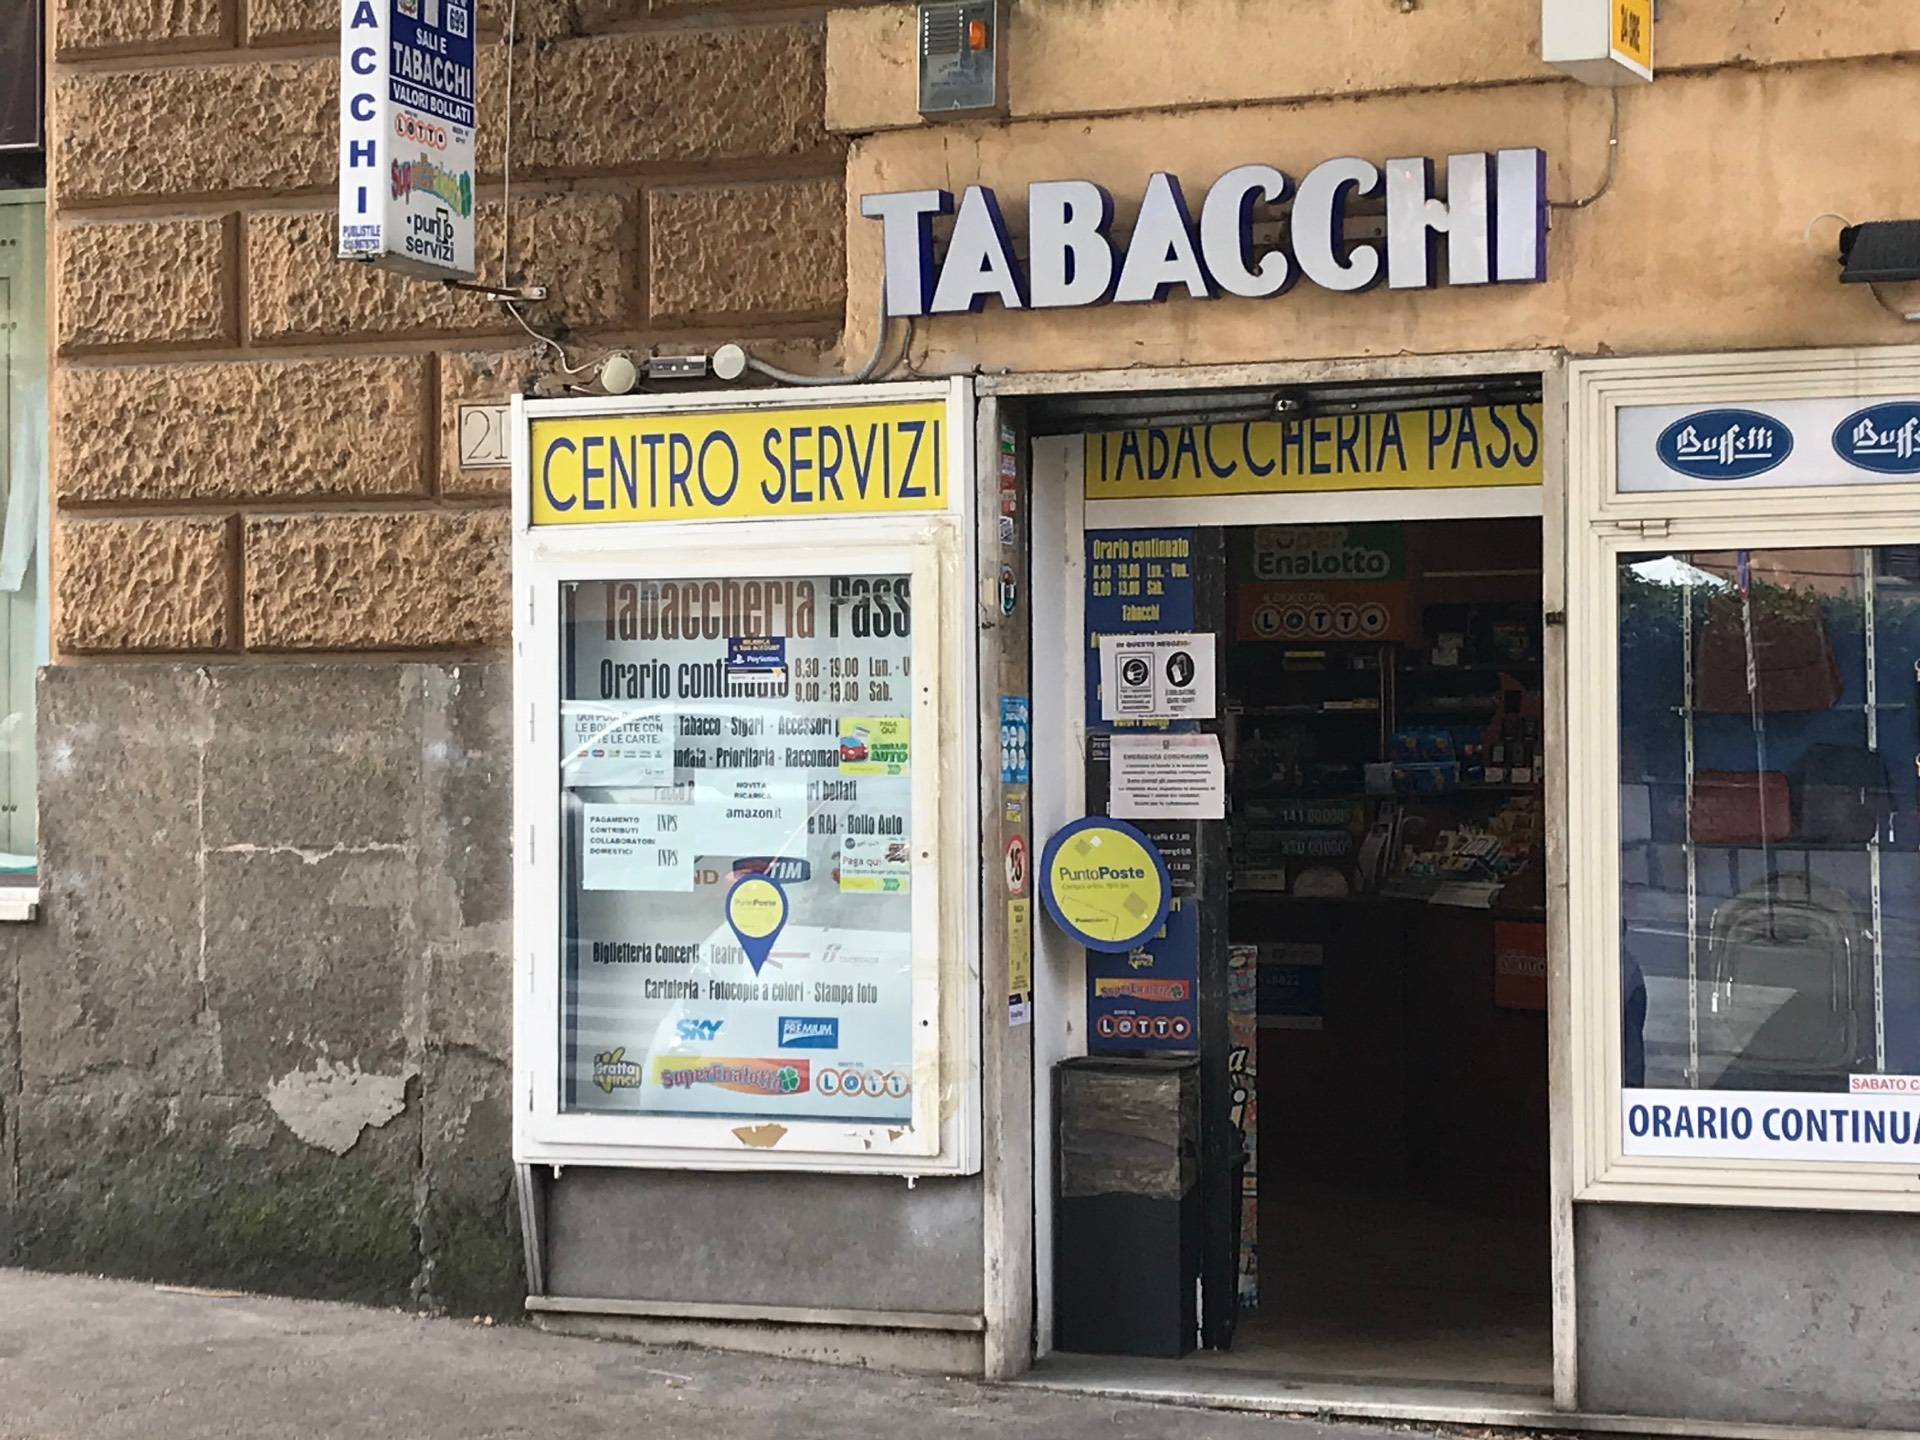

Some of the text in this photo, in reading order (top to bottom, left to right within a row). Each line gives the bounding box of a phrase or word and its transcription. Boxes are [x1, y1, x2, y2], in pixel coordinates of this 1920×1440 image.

[415, 27, 447, 54] SALI E
[393, 41, 471, 98] TABACCHI
[393, 83, 471, 123] VALORI BOLLATI
[395, 113, 447, 150] LOTTO
[861, 147, 1546, 317] TABACCHI
[406, 236, 454, 262] servizi
[465, 409, 511, 461] 21
[1676, 424, 1773, 464] Buffetti
[543, 419, 941, 511] CENTRO SERVIZI
[1093, 538, 1189, 559] Orario continuato
[1257, 551, 1385, 574] Enalotto
[604, 578, 816, 642] Tabaccheria
[1252, 602, 1391, 638] LOTTO
[600, 657, 671, 700] Orario
[869, 681, 893, 701] Sab.
[576, 723, 589, 732] LE
[643, 723, 664, 733] CON
[679, 716, 721, 736] Tabacco
[731, 716, 764, 737] Sigari
[778, 714, 832, 736] Accessori
[611, 734, 624, 743] LE
[716, 748, 775, 767] Prioritaria
[785, 747, 838, 767] Raccoman
[657, 813, 678, 832] INPS
[847, 814, 875, 835] Bollo
[878, 814, 904, 836] Auto
[658, 849, 679, 866] INPS
[769, 861, 802, 880] TIM
[1059, 866, 1145, 881] PuntoPoste
[593, 941, 652, 964] Biglietteria
[709, 980, 760, 1002] Fotocopie
[762, 984, 769, 1001] a
[814, 982, 854, 1005] Stampa
[857, 983, 878, 1004] foto
[784, 1023, 833, 1035] PREMIUM
[1097, 1015, 1192, 1040] LOTTO
[1852, 1078, 1907, 1091] SABATO
[1629, 1104, 1920, 1145] ORARIO CONTINU
